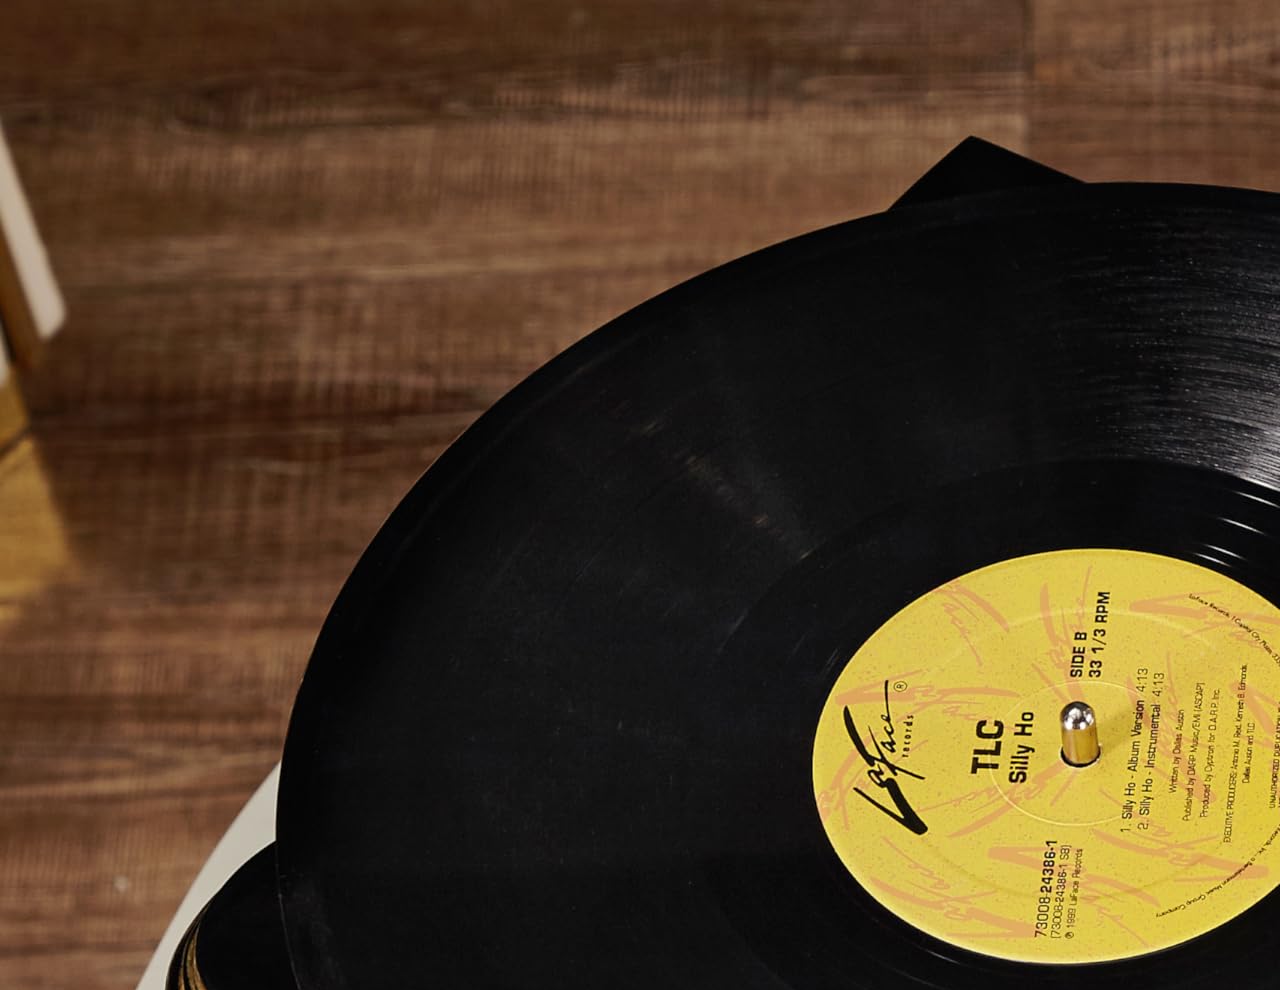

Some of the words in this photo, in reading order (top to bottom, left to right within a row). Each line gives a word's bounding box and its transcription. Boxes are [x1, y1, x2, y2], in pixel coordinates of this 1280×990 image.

[1094, 592, 1110, 623] RPM
[1074, 632, 1087, 640] B
[1091, 629, 1107, 654] 1/3
[1070, 646, 1085, 678] SIDE
[1089, 660, 1102, 678] 33
[1136, 668, 1148, 692] 4:13
[1152, 672, 1165, 697] 4:13
[1014, 712, 1034, 736] Ho
[1130, 700, 1145, 737] Version
[1175, 709, 1185, 731] Austin
[1247, 723, 1255, 733] TLC
[901, 715, 914, 758] records
[1145, 704, 1161, 768] Instrumental
[1172, 733, 1183, 754] Dallas
[1190, 714, 1201, 753] Music/EMI
[1207, 732, 1216, 743] for
[1245, 735, 1254, 745] and
[843, 680, 928, 836] LaFace
[970, 720, 1004, 774] TLC
[1127, 741, 1141, 772] Album
[1244, 747, 1253, 765] Austin
[1008, 745, 1035, 784] Silly
[1171, 756, 1181, 764] by
[1187, 754, 1196, 775] DARP
[1223, 811, 1234, 843] EXECUTIVE
[1230, 749, 1240, 770] Antonio
[1236, 700, 1244, 722] Kenneth
[1124, 782, 1136, 796] Ho
[1141, 779, 1154, 793] Ho
[1169, 767, 1180, 793] Written
[1186, 778, 1196, 786] by
[1203, 774, 1213, 782] by
[1269, 759, 1280, 808] UNAUTHORIZED
[1121, 800, 1137, 820] Silly
[1139, 796, 1154, 816] Silly
[1182, 788, 1194, 821] Published
[1200, 784, 1211, 818] Produced
[1120, 824, 1132, 833] 1.
[1137, 820, 1149, 830] 2.
[1072, 848, 1083, 878] Records
[1034, 840, 1057, 938] 73008-24386-1
[1069, 881, 1080, 906] LaFace
[1066, 908, 1076, 928] 1999
